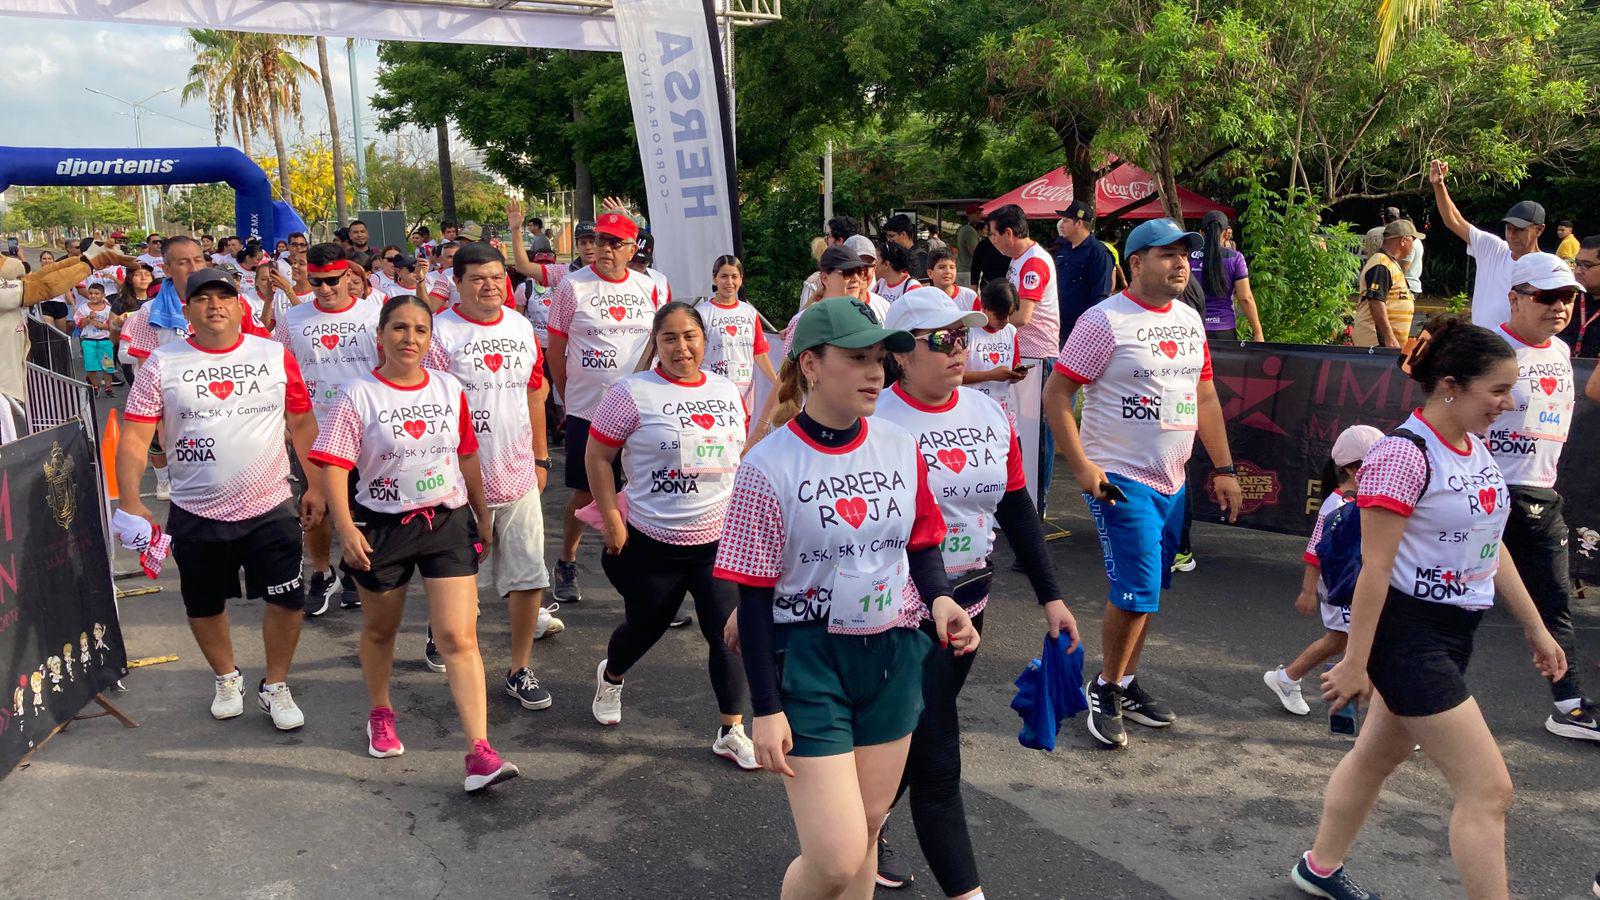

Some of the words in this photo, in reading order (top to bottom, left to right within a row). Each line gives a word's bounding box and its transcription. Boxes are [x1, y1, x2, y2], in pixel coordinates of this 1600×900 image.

[56, 158, 174, 177] dportenis
[1100, 177, 1155, 200] Coca-Col
[590, 293, 646, 307] CARRERA
[712, 315, 752, 327] CARRERA
[302, 322, 367, 337] CARRERA
[1137, 326, 1200, 341] CARRERA
[464, 338, 528, 356] CARRERA
[582, 357, 618, 368] DONA
[182, 363, 270, 383] CARRERA
[208, 409, 222, 418] 5K
[227, 410, 233, 418] y
[378, 404, 455, 424] CARRERA
[662, 399, 738, 416] CARRERA
[1122, 406, 1160, 420] DON
[1176, 402, 1196, 415] 069
[471, 410, 491, 420] ICO
[1539, 411, 1561, 424] 044
[473, 420, 492, 433] NA
[919, 425, 998, 449] ARRERA
[405, 448, 417, 457] 5K
[420, 449, 427, 457] y
[696, 445, 725, 458] 077
[1490, 440, 1537, 454] DONA
[176, 449, 216, 463] DONA
[416, 474, 445, 492] 008
[650, 480, 699, 494] DONA
[797, 470, 906, 503] CARRERA
[943, 486, 959, 498] 5K
[963, 486, 971, 498] y
[838, 544, 855, 558] 5K
[858, 544, 866, 558] y
[870, 536, 907, 552] Camin
[858, 587, 892, 612] 114
